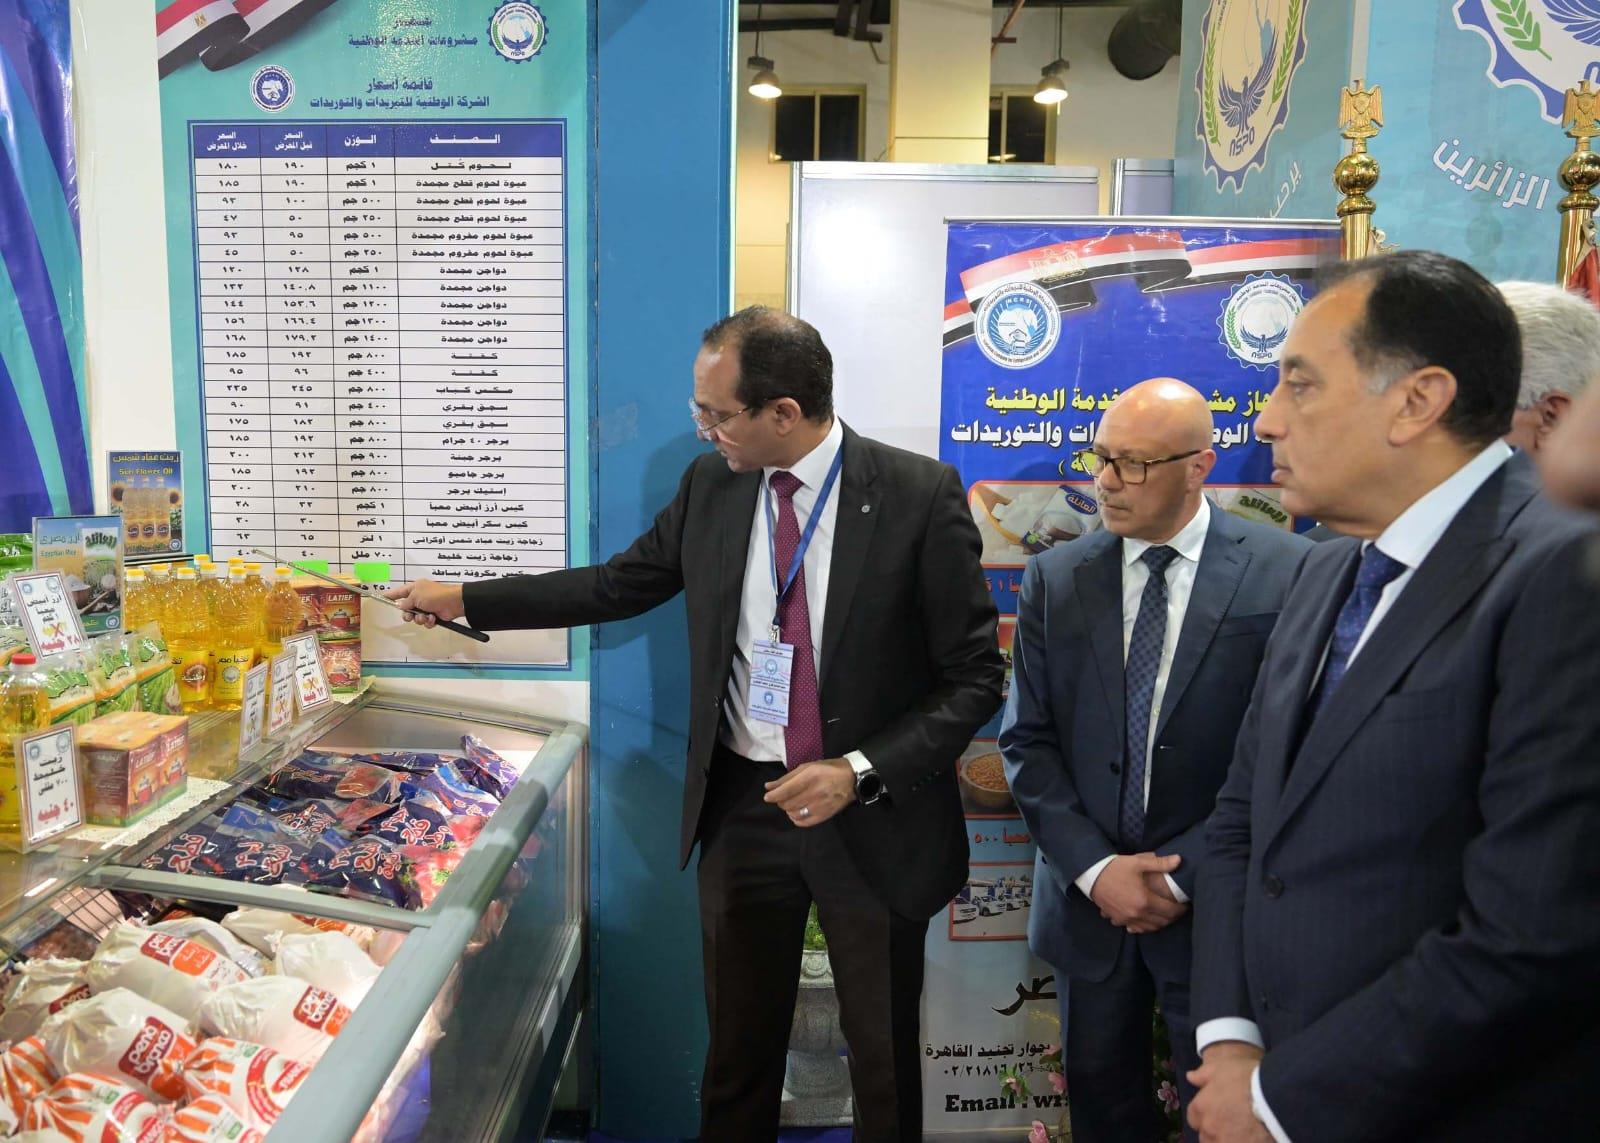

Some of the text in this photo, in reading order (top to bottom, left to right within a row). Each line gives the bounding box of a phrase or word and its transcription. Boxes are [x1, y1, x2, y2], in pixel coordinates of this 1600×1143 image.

[402, 77, 433, 90] قائمة
[310, 96, 489, 110] الشركة الوطنية للتبريدات والتوريدات
[217, 131, 237, 140] السعر
[283, 130, 304, 140] السعر
[344, 134, 376, 146] الوزن
[429, 133, 501, 144] الصنف
[206, 142, 230, 151] المعرض
[274, 141, 298, 151] المعرض
[345, 160, 367, 172] كجم
[468, 162, 512, 172] لحوم
[1432, 136, 1550, 210] الزائرين
[218, 179, 240, 187] ١٨٥
[285, 179, 305, 187] ١٩٠
[345, 178, 368, 189] كجم
[415, 179, 527, 189] عبوة لحوم قطع مجمدة
[285, 196, 305, 204] ١٠٠
[415, 196, 528, 207] عبوة لحوم قطع مجمدة
[416, 214, 528, 224] عبوة لحوم قطع مجمدة
[343, 232, 360, 242] جم
[411, 232, 534, 241] عبوة لحوم مفروم مجمدة
[411, 249, 534, 259] عبوة لحوم مفروم مجمدة
[348, 265, 370, 276] كجم
[439, 266, 507, 276] دواجن مجمدة
[223, 283, 244, 291] ١٣٢
[439, 283, 508, 293] دواجن مجمدة
[224, 300, 244, 308] ١٤٤
[342, 301, 359, 311] جم
[440, 301, 508, 311] دواجن مجمدة
[440, 318, 508, 328] دواجن مجمدة
[225, 334, 247, 342] ١٦٨
[440, 335, 508, 345] دواجن مجمدة
[291, 351, 312, 359] ١٩٢
[347, 369, 364, 378] جم
[291, 384, 313, 392] ٢٤٥
[985, 387, 1066, 415] الوطنية
[476, 403, 509, 413] سجق
[476, 420, 509, 429] سجق
[229, 434, 250, 442] ١٨٥
[294, 434, 314, 442] ١٩٢
[950, 420, 1063, 450] والتوريدات
[349, 436, 366, 446] جم
[441, 436, 510, 446] برجر جرام
[450, 453, 502, 463] برجر جبنة
[479, 472, 505, 480] برجر
[231, 483, 251, 491] ٢٠٠
[295, 484, 315, 492] ٢١٠
[446, 488, 471, 496] برجر
[356, 501, 377, 512] كجم
[429, 501, 525, 513] كيس أرز أبيض معبأ
[356, 517, 377, 528] كجم
[426, 517, 529, 529] كيس سكر أبيض معبأ
[495, 538, 515, 546] زيت
[516, 537, 544, 546] زجاجة
[437, 552, 519, 563] زجاجة زيت خليط
[327, 594, 353, 602] LATIEF
[925, 1043, 973, 1060] القاهرة
[977, 1042, 1015, 1060] تجنيد
